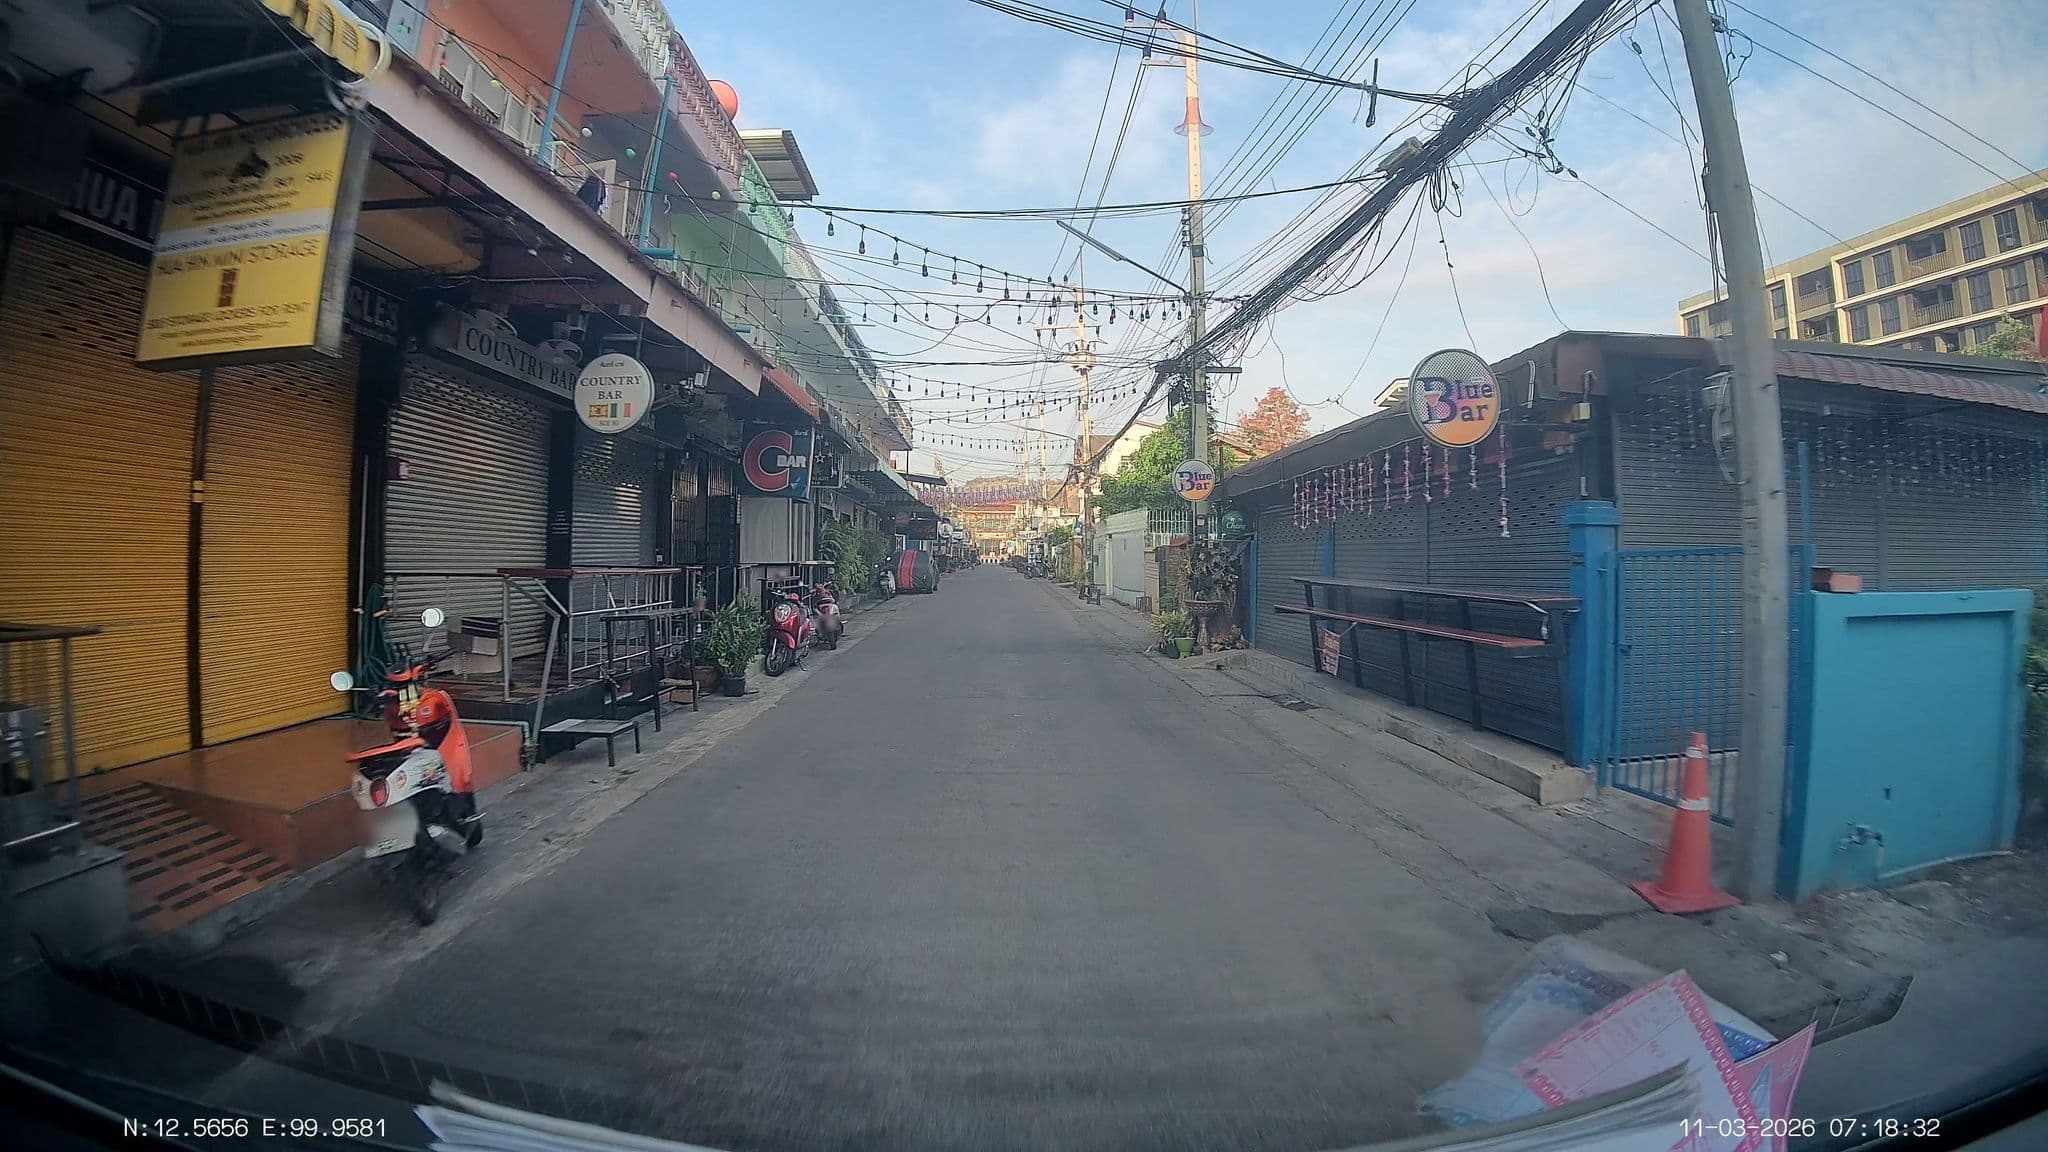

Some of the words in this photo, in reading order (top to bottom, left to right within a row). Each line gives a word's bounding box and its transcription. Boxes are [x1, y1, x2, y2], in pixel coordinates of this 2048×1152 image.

[466, 328, 543, 380] COUNTRY
[550, 367, 577, 392] BAR
[580, 375, 641, 387] COUNTRY
[1415, 376, 1493, 410] Blue
[598, 390, 622, 399] BAR
[743, 429, 792, 492] C
[776, 454, 806, 468] BAR
[1176, 471, 1212, 485] Blue
